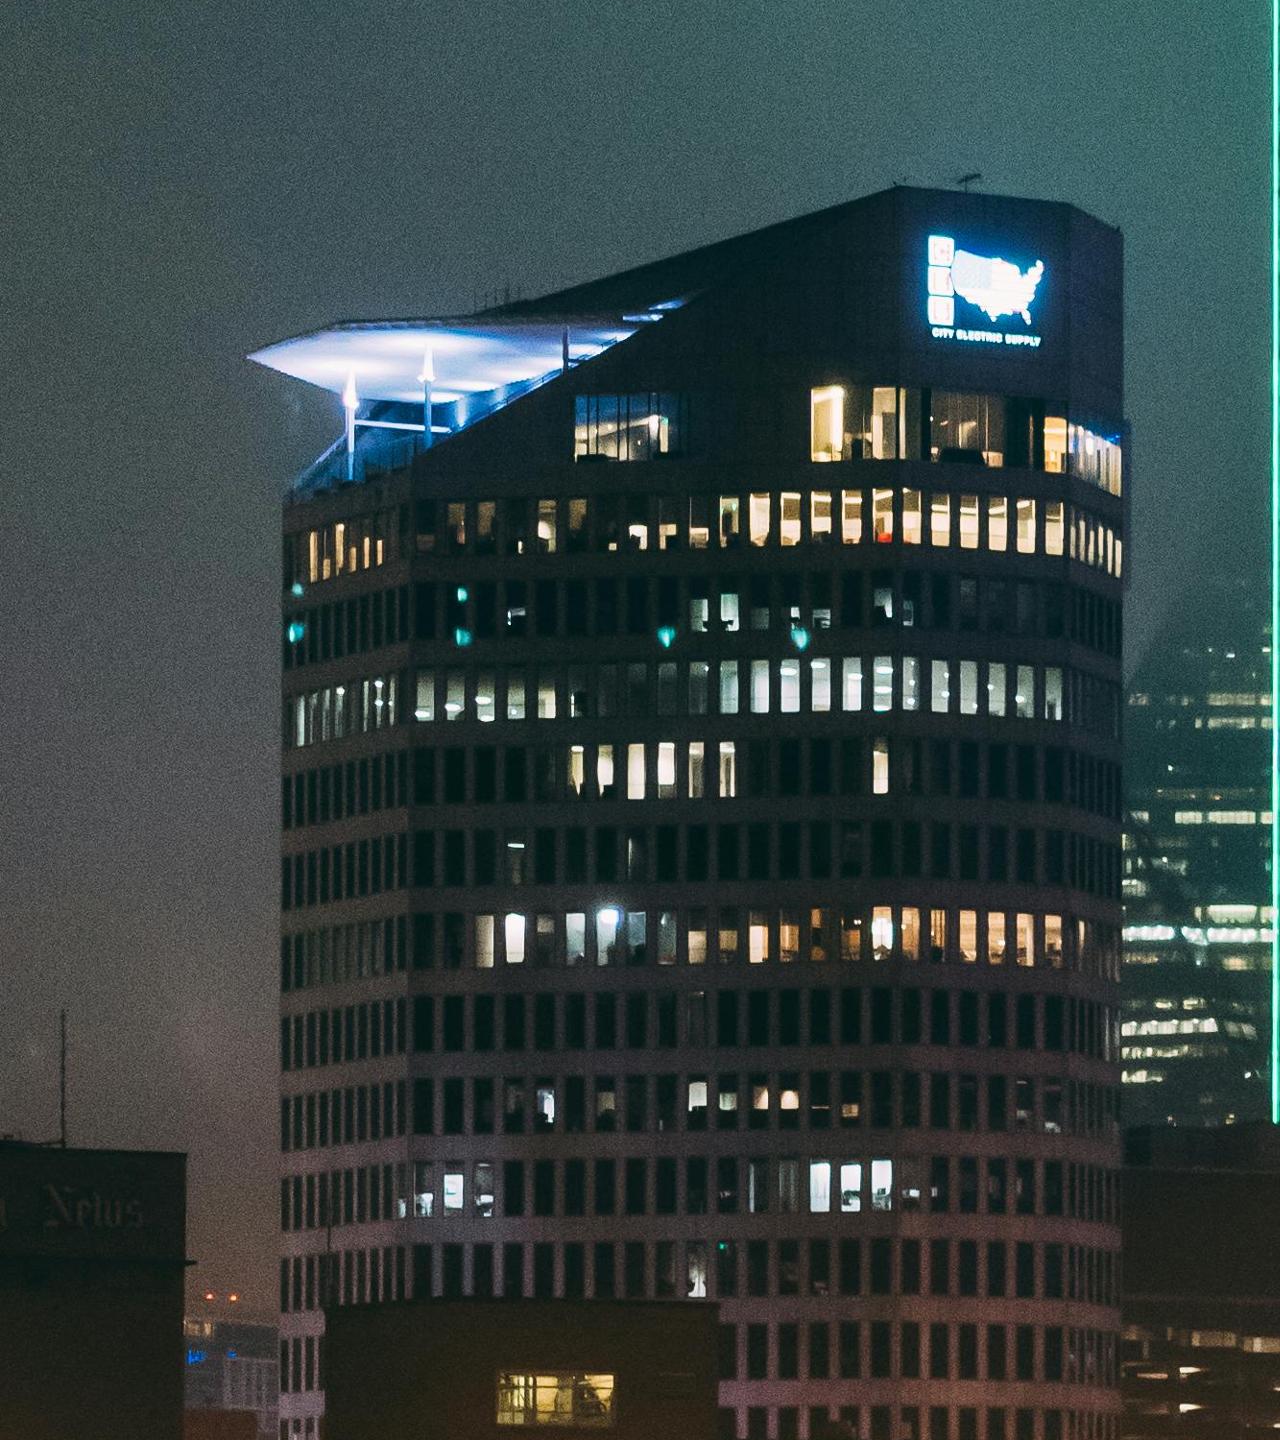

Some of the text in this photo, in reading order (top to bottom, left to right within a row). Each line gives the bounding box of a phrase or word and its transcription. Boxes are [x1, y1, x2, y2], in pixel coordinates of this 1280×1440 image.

[931, 327, 1041, 348] CITY ELECTRIC SUPPLY
